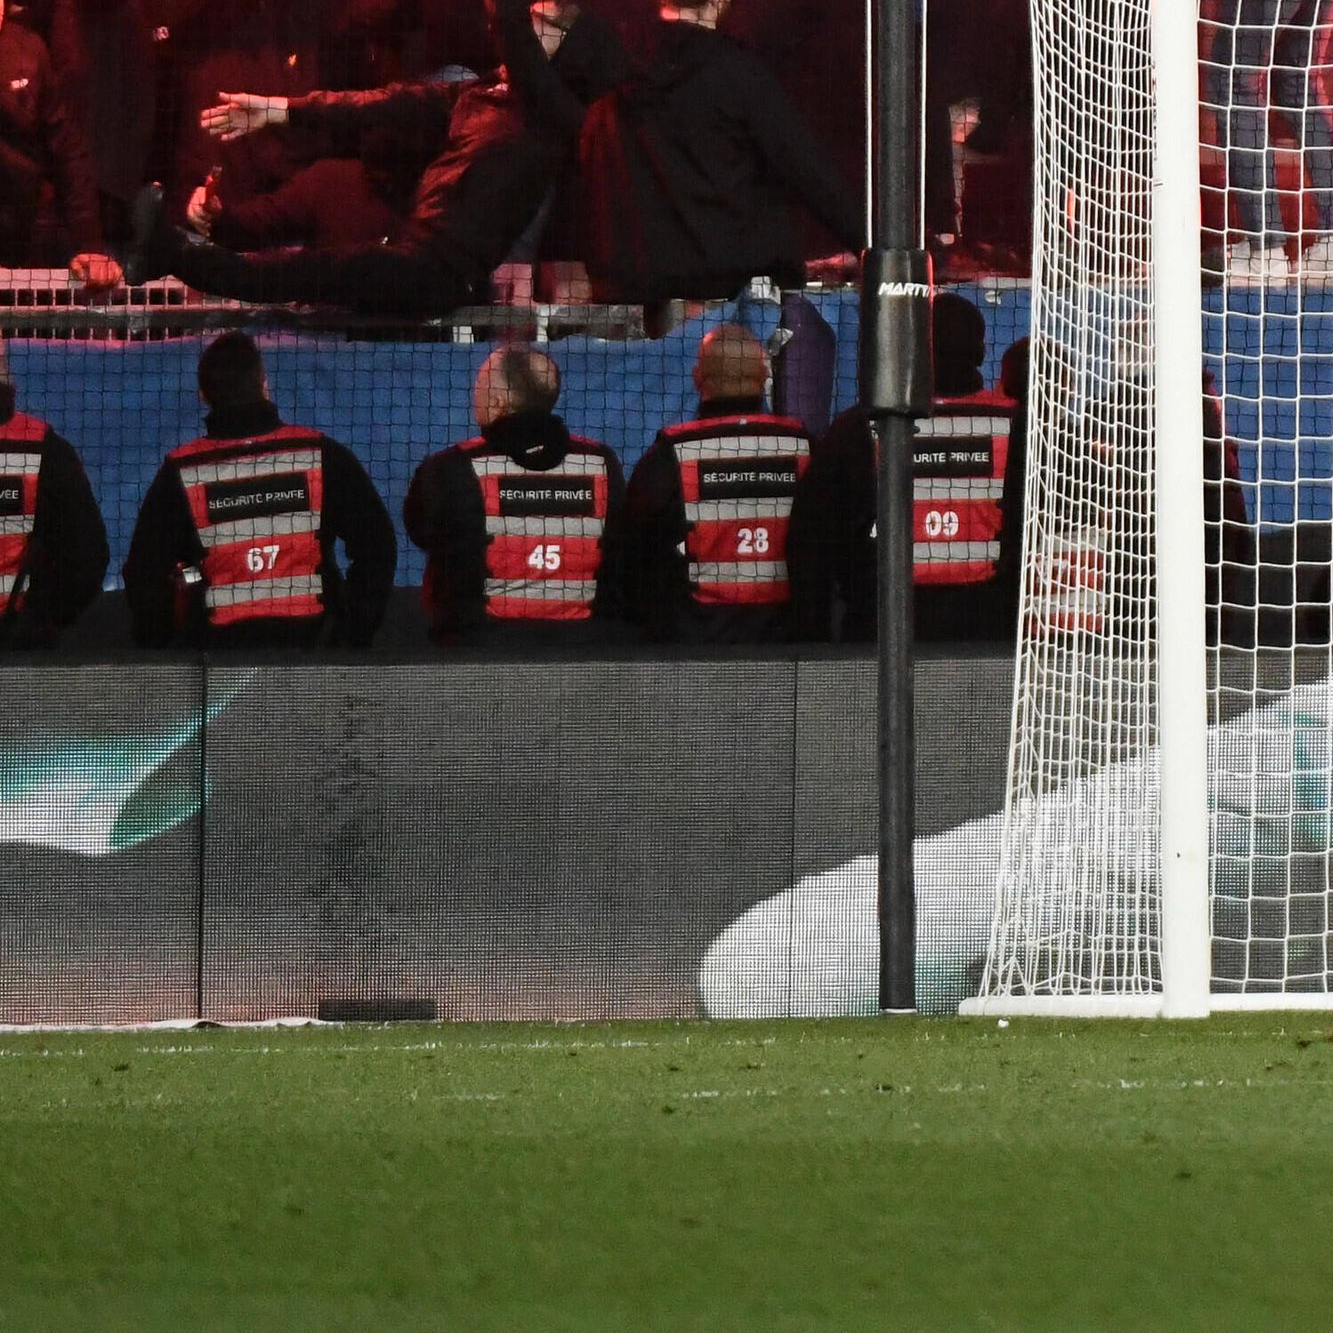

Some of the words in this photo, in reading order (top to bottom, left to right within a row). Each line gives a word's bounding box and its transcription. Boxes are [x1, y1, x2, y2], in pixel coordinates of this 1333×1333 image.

[925, 511, 958, 536] 09
[737, 529, 769, 554] 28
[246, 545, 280, 572] 67
[528, 545, 561, 570] 45
